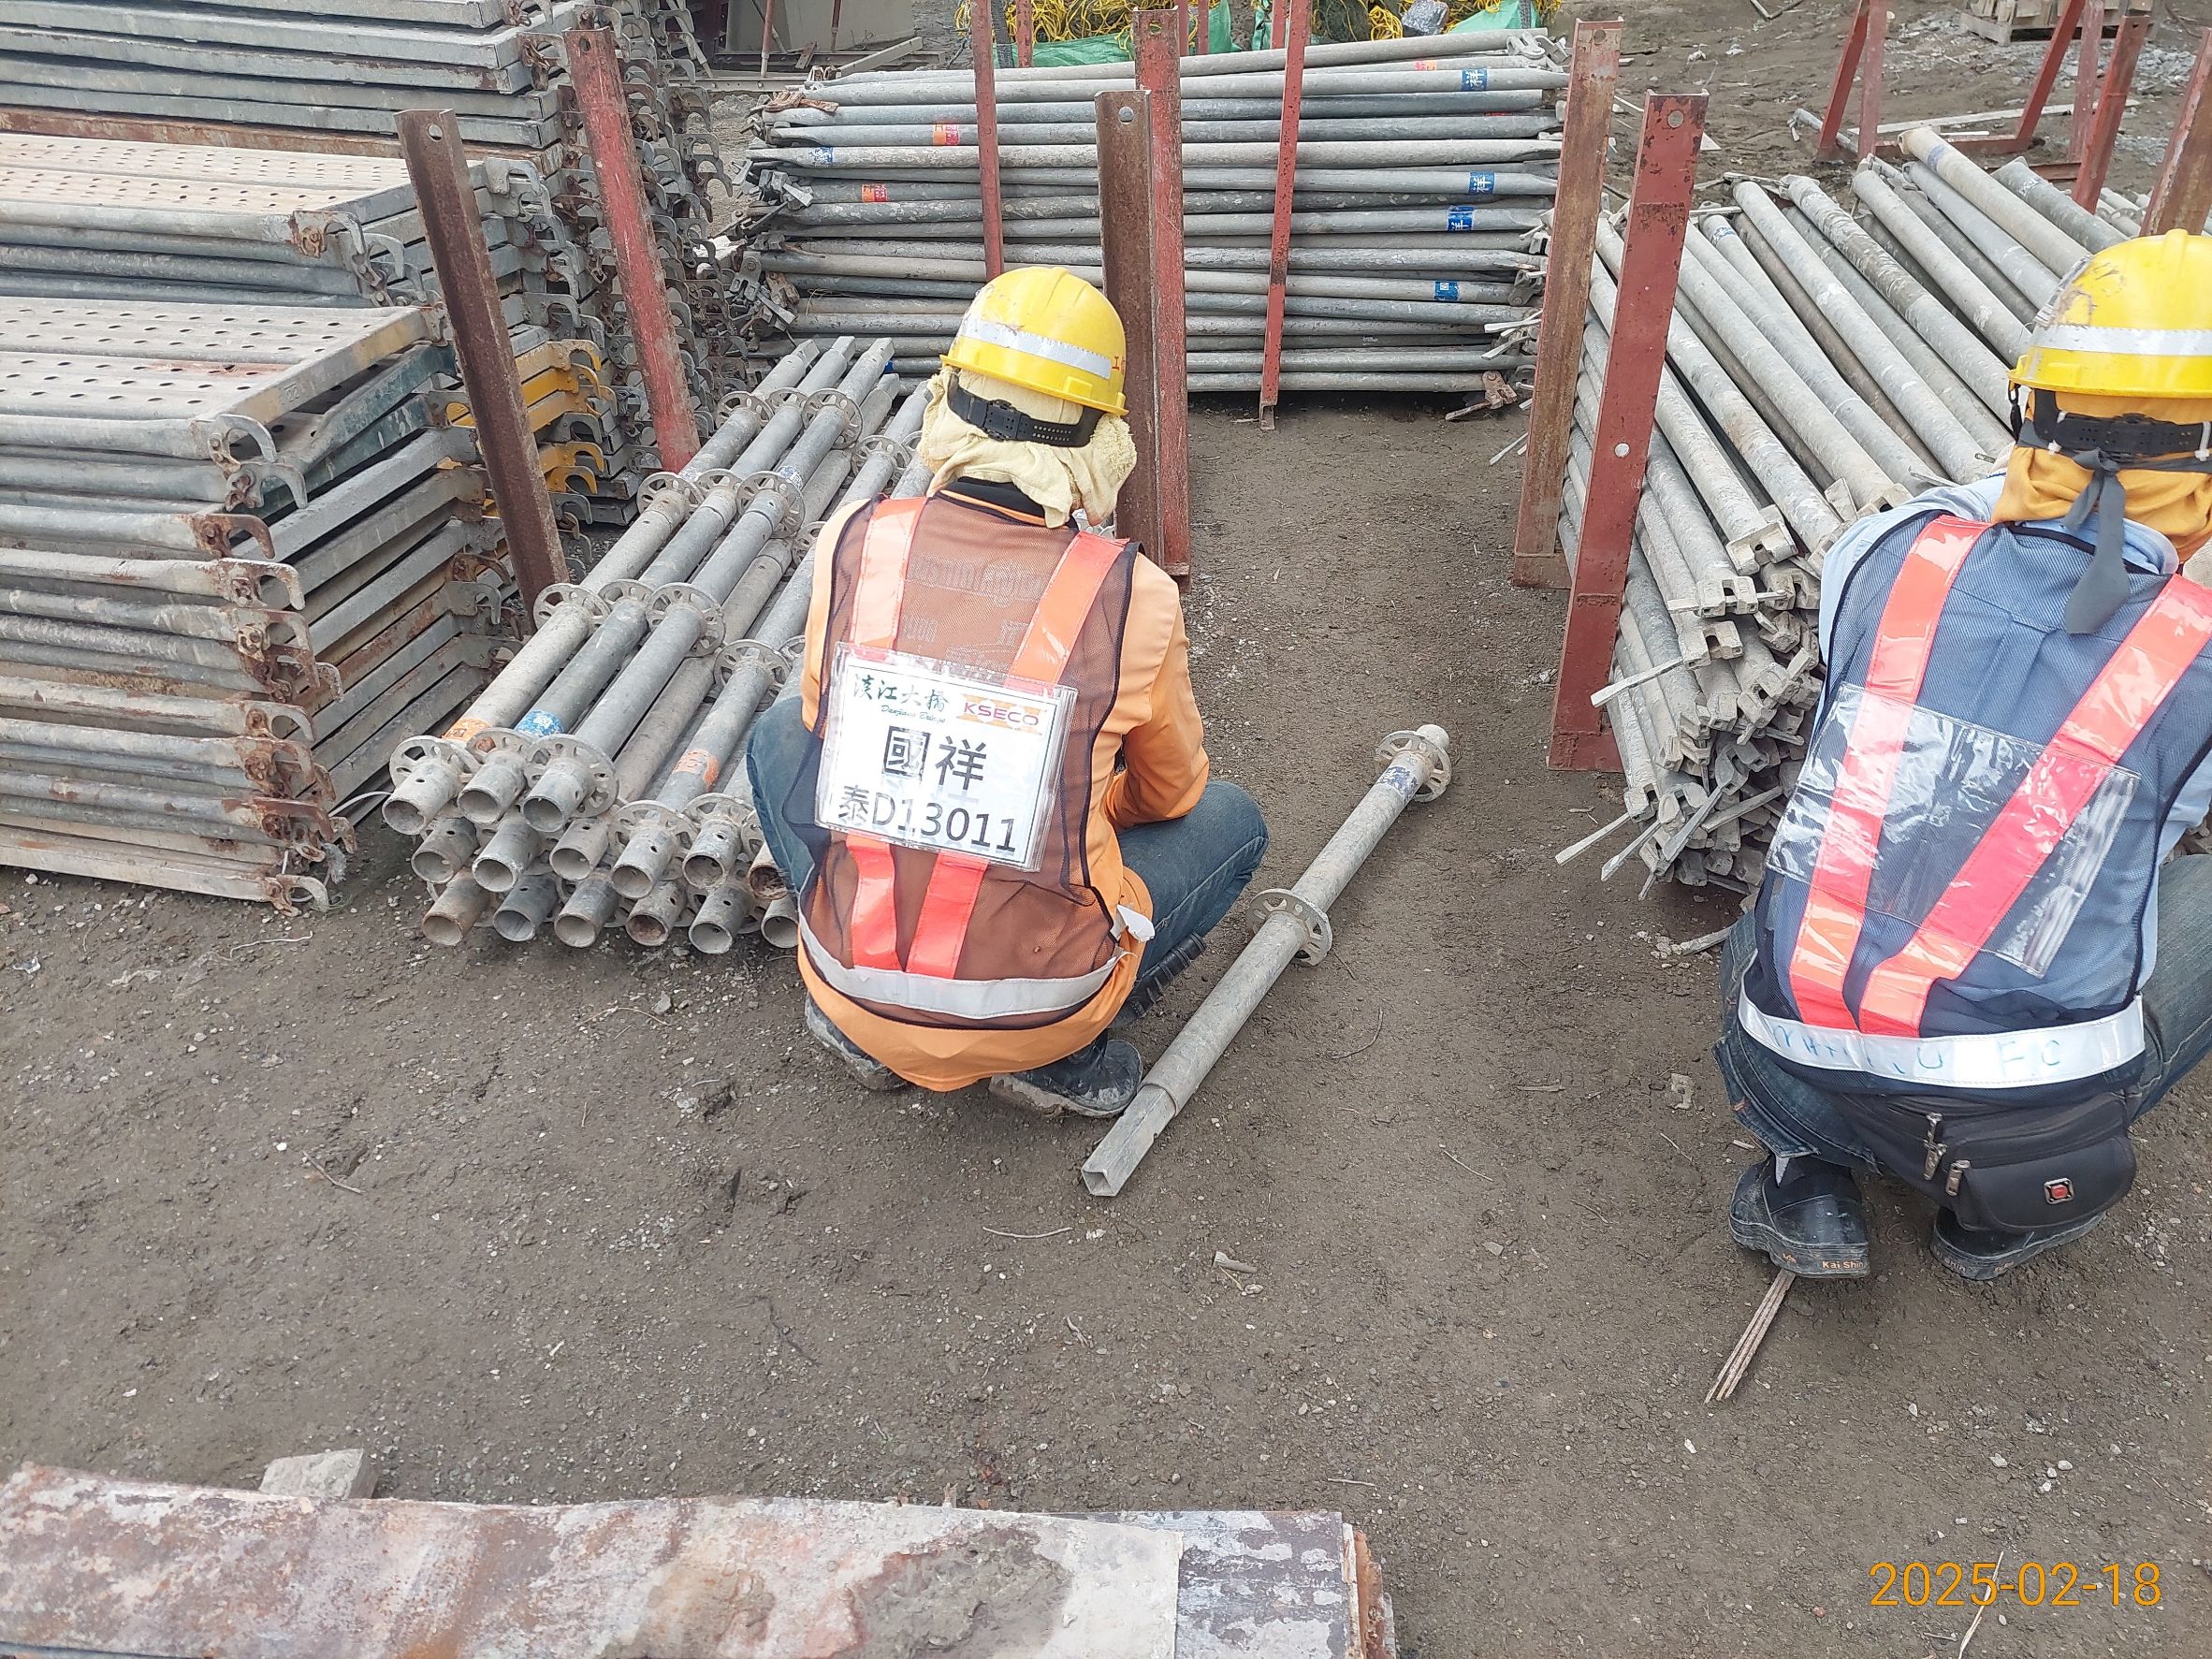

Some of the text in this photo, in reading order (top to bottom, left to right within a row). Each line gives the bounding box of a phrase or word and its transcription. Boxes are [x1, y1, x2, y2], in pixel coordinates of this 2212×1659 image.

[852, 673, 949, 712] 淡江大橋
[963, 702, 1040, 726] KSECO
[882, 724, 987, 791] 國祥
[837, 783, 1017, 853] 泰D13011
[1822, 1260, 1841, 1270] Kai
